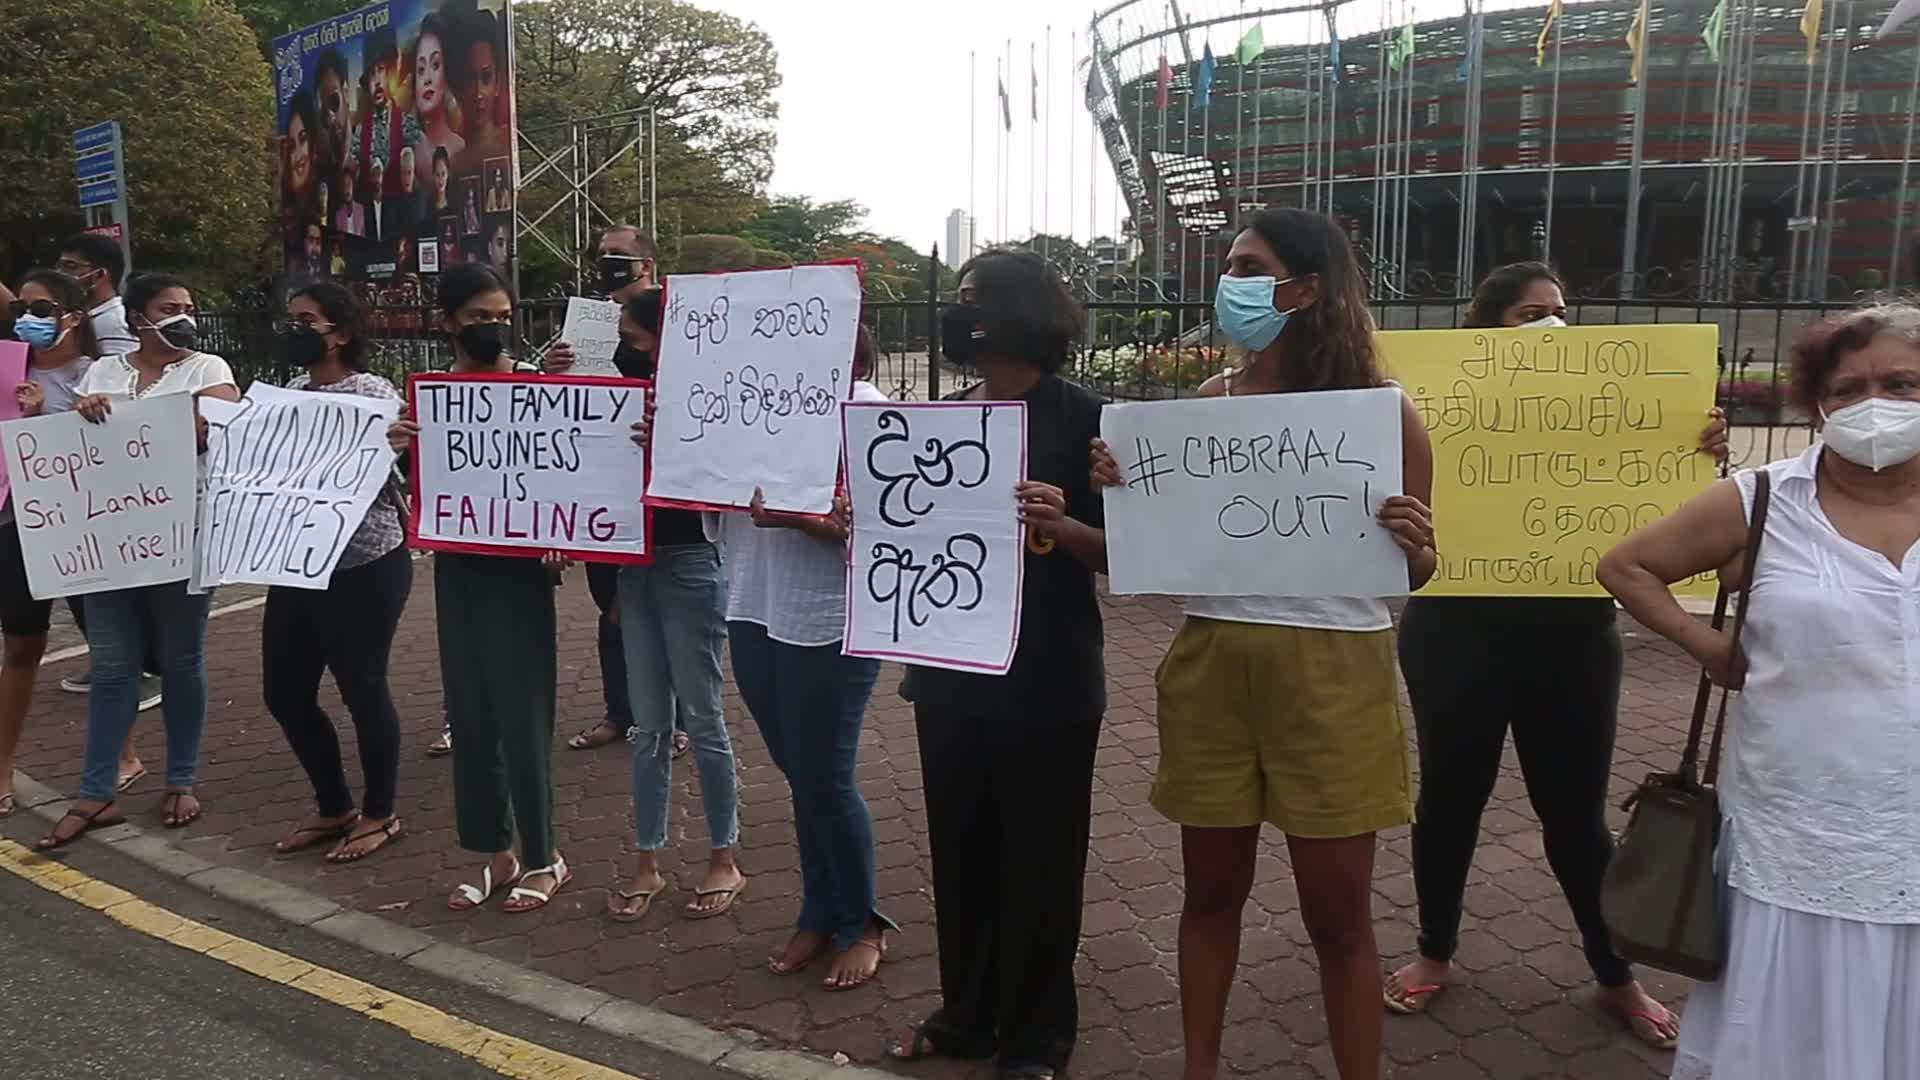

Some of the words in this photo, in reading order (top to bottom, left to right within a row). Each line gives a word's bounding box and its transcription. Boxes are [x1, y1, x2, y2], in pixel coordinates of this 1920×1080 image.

[750, 296, 831, 339] තමයි
[1460, 333, 1689, 387] அடிப்படை
[418, 384, 494, 424] THIS
[509, 384, 631, 424] FAMILY
[679, 371, 734, 442] දුක්
[1412, 379, 1663, 445] த்தியாவசிய
[15, 428, 105, 492] People
[126, 423, 153, 460] of
[446, 426, 582, 473] BUSINESS
[866, 404, 993, 528] දැන්
[1127, 427, 1376, 497] #CABRAAL
[1458, 444, 1701, 489] பொருட்கள்
[23, 499, 68, 530] Sri
[85, 482, 174, 522] Lanka
[502, 471, 528, 502] IS
[1217, 480, 1371, 539] OUT!
[206, 489, 354, 579] FUTURES
[434, 494, 617, 543] FAILING
[52, 532, 104, 578] will
[118, 521, 187, 568] rise!!
[866, 533, 988, 643] ඇති
